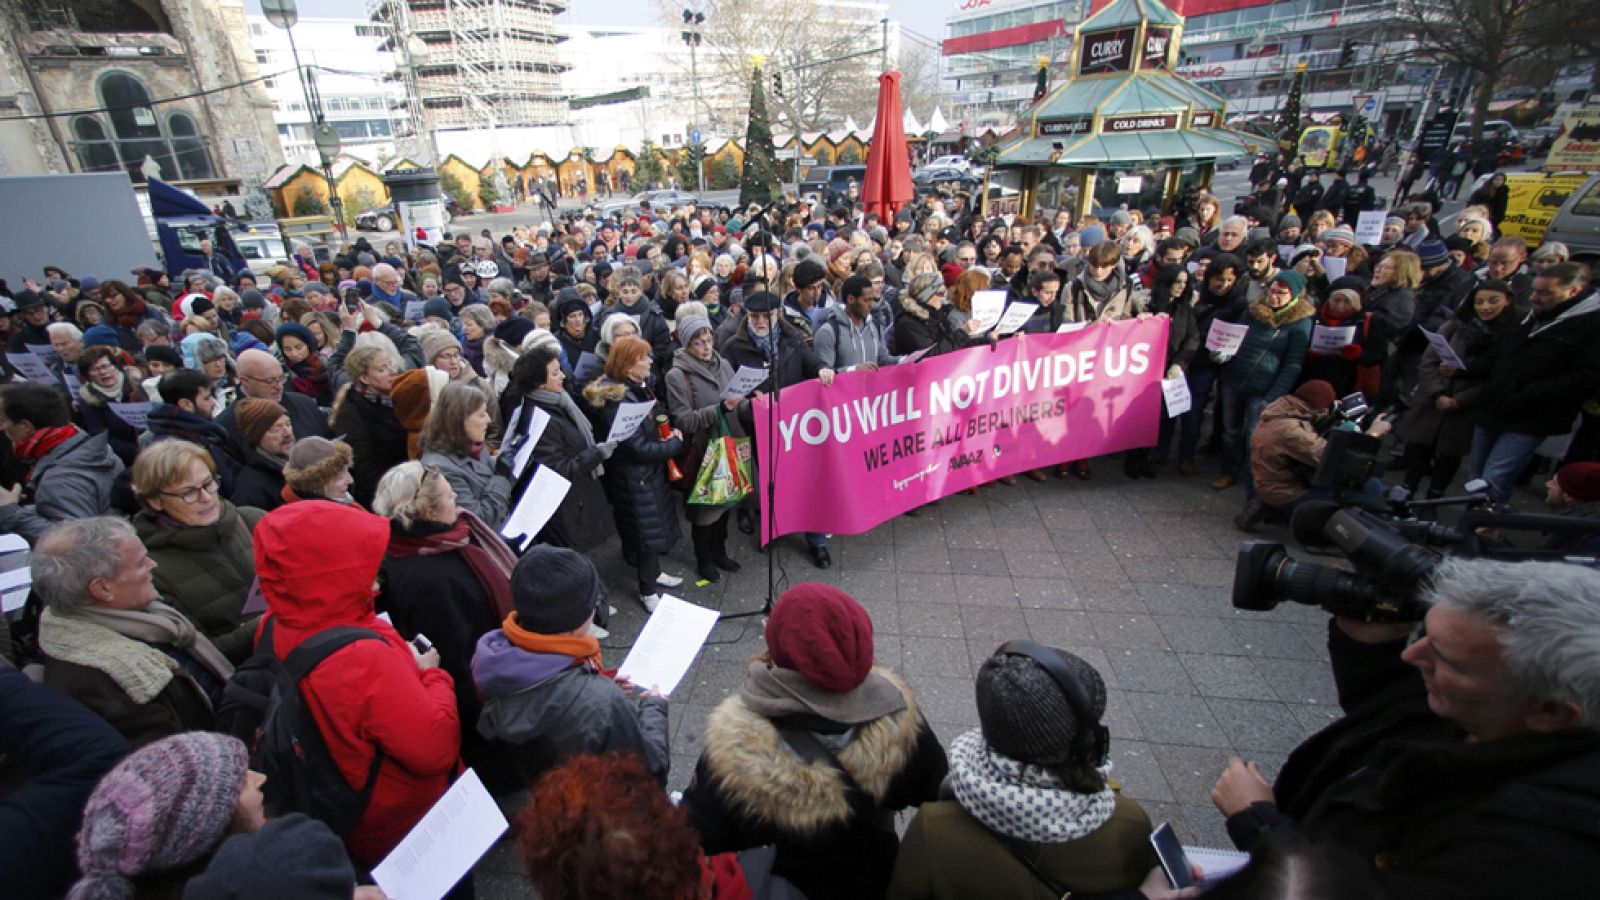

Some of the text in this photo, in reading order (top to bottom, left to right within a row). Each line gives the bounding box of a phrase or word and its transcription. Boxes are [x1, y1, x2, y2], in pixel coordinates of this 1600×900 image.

[1091, 38, 1125, 58] CURRY
[1113, 117, 1165, 130] COLD DRINKS
[778, 342, 1151, 452] YOU WILL NOT DIVIDE US
[864, 398, 1066, 472] WE ARE ALL BERLINERS
[949, 449, 984, 470] AVAAZ
